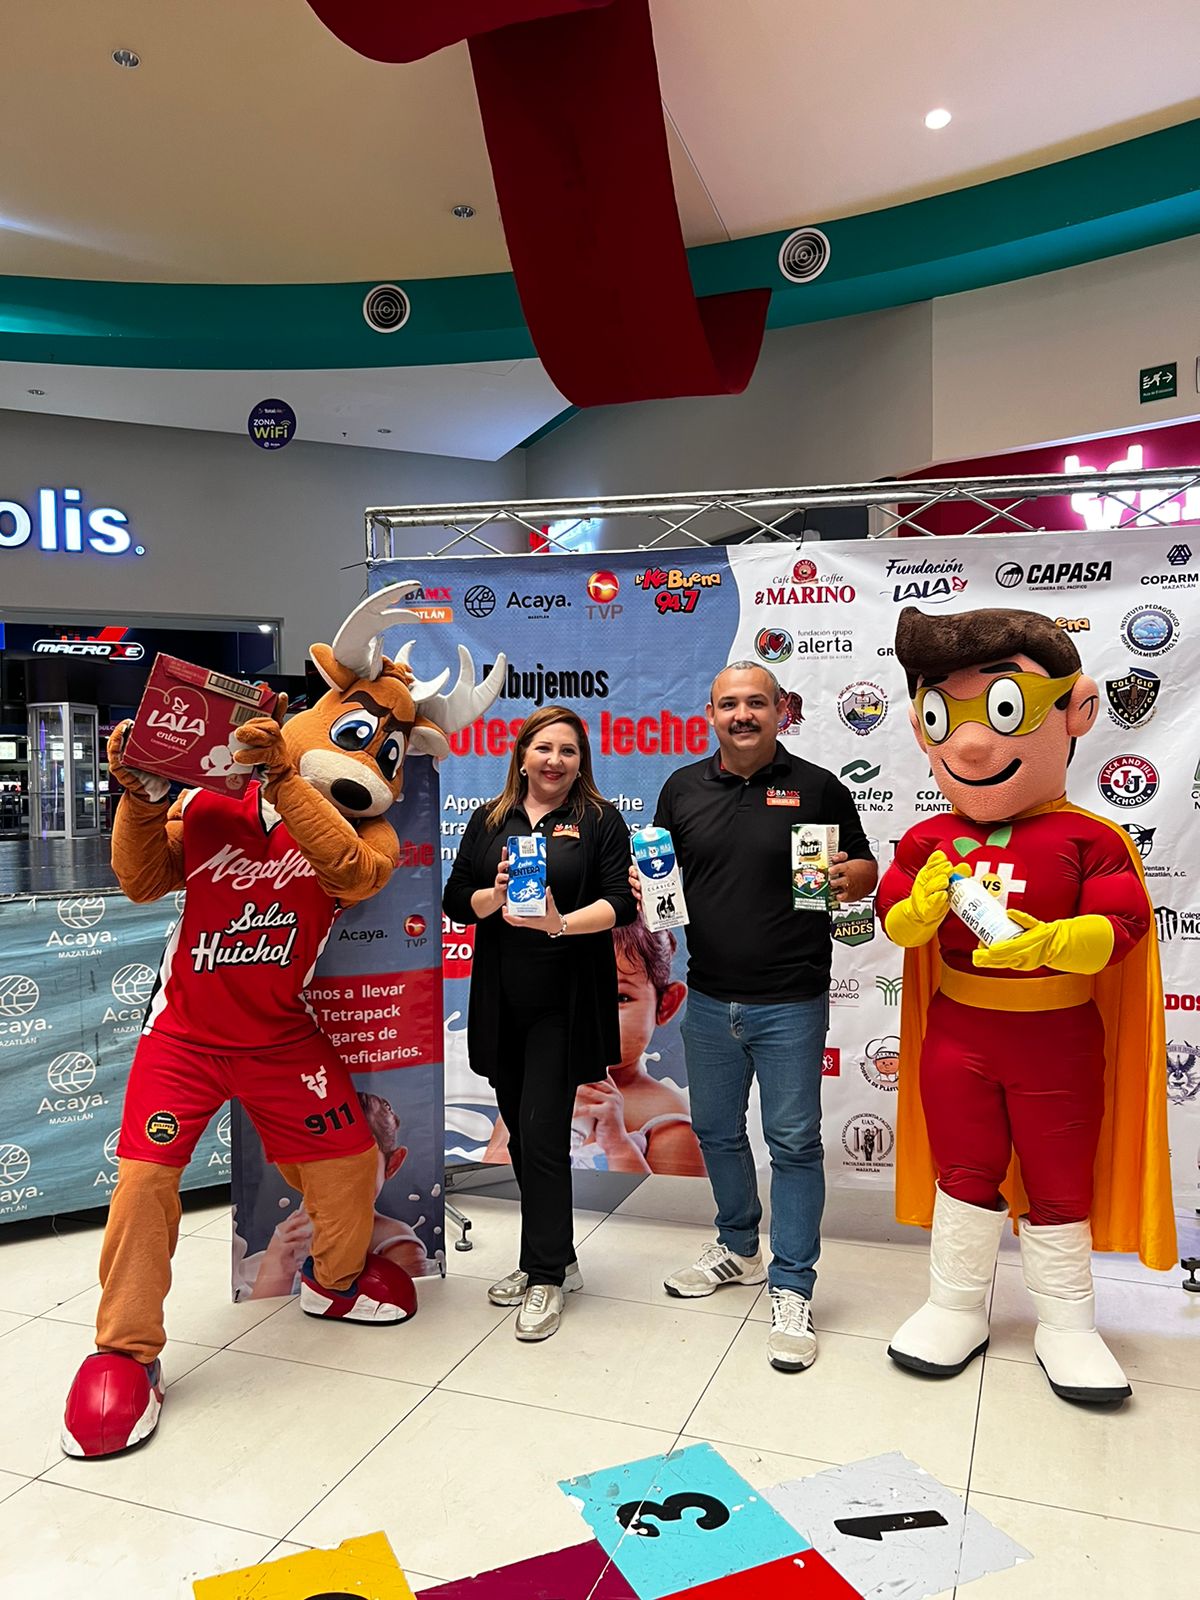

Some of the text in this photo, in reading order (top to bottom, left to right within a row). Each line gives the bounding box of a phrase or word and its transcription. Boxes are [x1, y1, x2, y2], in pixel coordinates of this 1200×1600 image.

[254, 426, 288, 438] WiFi
[885, 558, 964, 578] Fundación
[1026, 561, 1112, 584] CAPASA
[772, 573, 844, 586] Café Coffee
[1140, 573, 1199, 586] COPARM
[766, 585, 856, 606] MARINO
[892, 578, 952, 603] LALA
[506, 591, 572, 612] Acaya.
[654, 590, 700, 614] 94.7
[586, 604, 624, 620] TVP
[1120, 605, 1144, 630] INSTITUTO
[1055, 616, 1090, 632] ena
[798, 637, 853, 654] alerta
[877, 648, 894, 656] GR
[483, 664, 609, 707] bujemos
[1112, 676, 1154, 688] COLEGIO
[1110, 691, 1118, 702] EL
[146, 709, 206, 736] LALA
[156, 730, 188, 746] entera
[440, 709, 710, 760] otes leche
[1103, 758, 1154, 778] JACK AND JILL
[850, 788, 894, 803] nalep
[916, 790, 945, 800] con
[1110, 794, 1148, 805] SCHOOL
[443, 794, 643, 815] Apo che
[870, 804, 886, 812] No.
[887, 804, 894, 812] 2
[440, 820, 467, 836] tra
[796, 842, 822, 856] Nutri
[225, 902, 297, 934] Salsa
[836, 920, 868, 928] COLEGIO
[961, 908, 980, 930] CARB
[1180, 912, 1200, 920] Coleg
[338, 928, 388, 942] Acaya.
[834, 922, 874, 938] ANDES
[1181, 920, 1200, 934] Mo
[46, 930, 118, 948] Acaya.
[403, 938, 428, 948] TVP
[978, 926, 994, 946] LOW
[58, 949, 102, 958] MAZATLÁN
[190, 927, 297, 972] Huichol
[442, 943, 473, 960] zo
[303, 984, 406, 1000] anos a llevar
[829, 978, 860, 992] DAD
[102, 1006, 146, 1024] Aca
[321, 1004, 401, 1024] Tetrapack
[0, 1018, 52, 1036] caya.
[0, 1036, 36, 1047] AZATLÁN
[330, 1026, 398, 1047] gares de
[340, 1046, 422, 1064] neficiarios.
[37, 1094, 109, 1114] Acaya.
[49, 1112, 94, 1124] MAZATLÁN
[304, 1102, 356, 1136] 911
[0, 1186, 44, 1204] aya.
[0, 1204, 28, 1214] ATLÁN
[616, 1492, 730, 1538] 3
[833, 1509, 949, 1541] 1
